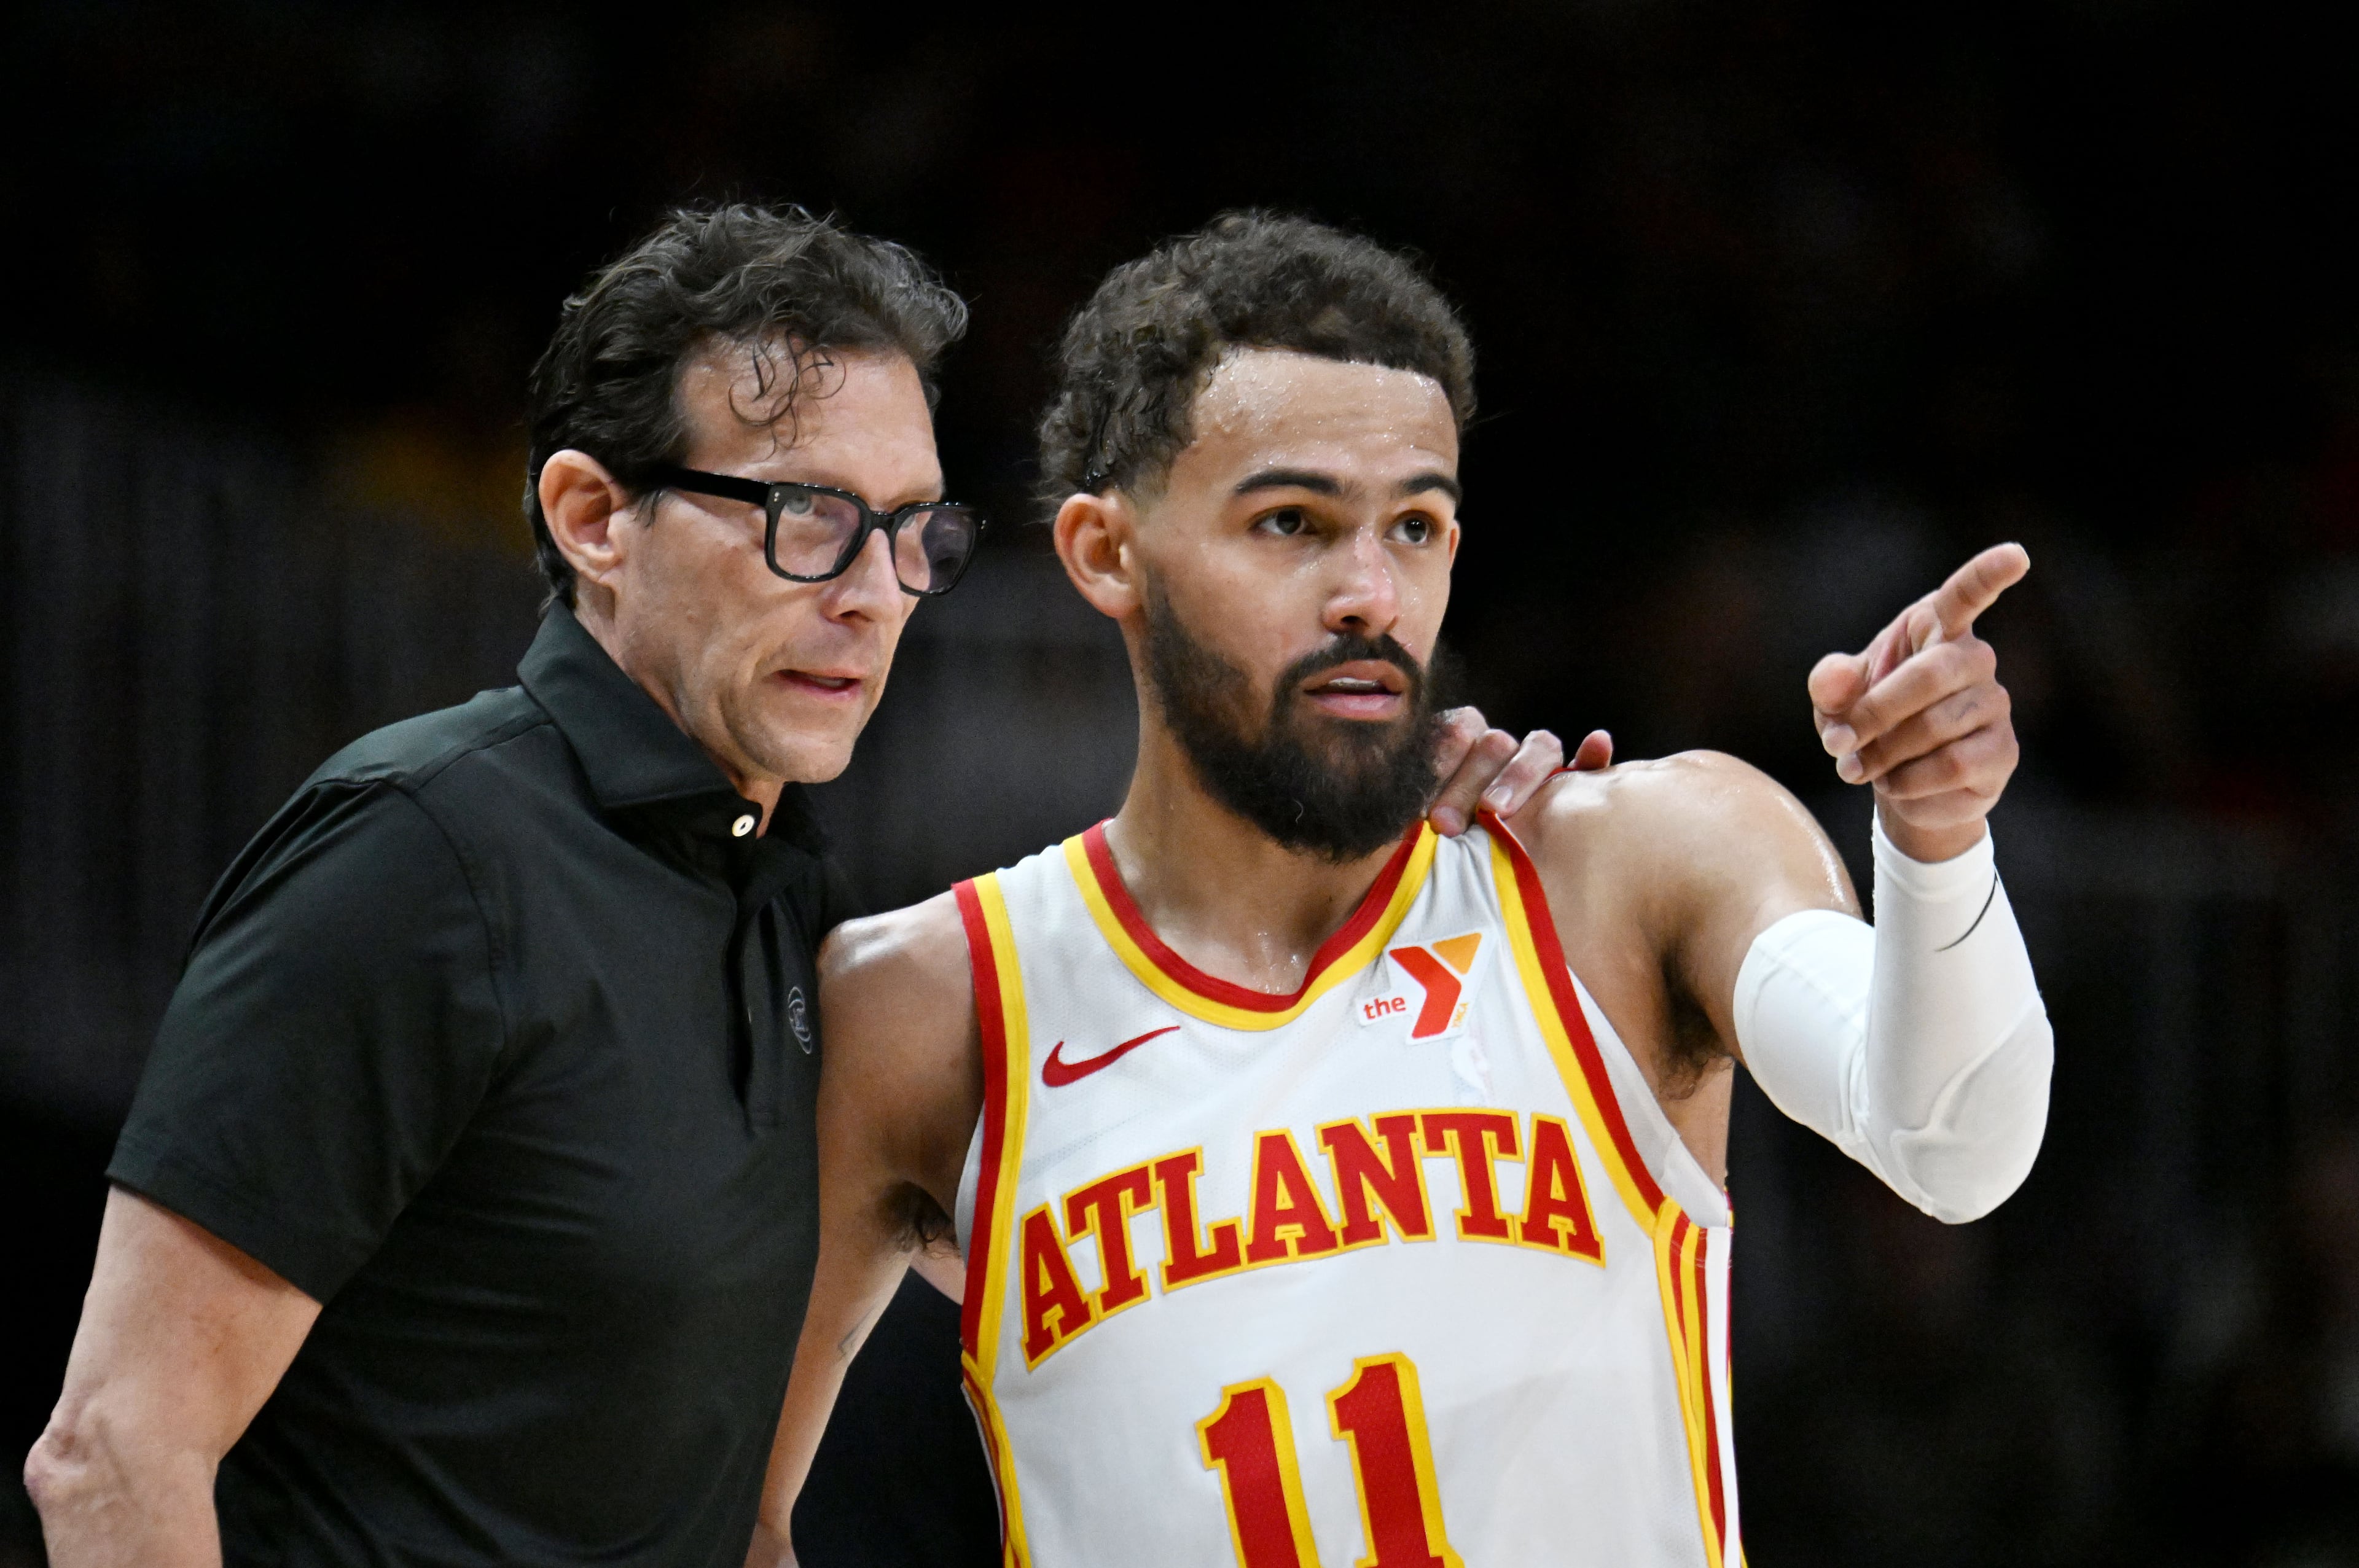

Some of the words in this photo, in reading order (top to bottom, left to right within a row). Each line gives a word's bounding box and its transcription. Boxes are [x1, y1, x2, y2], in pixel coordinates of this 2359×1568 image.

[1363, 997, 1406, 1020] the
[1020, 1109, 1606, 1372] ATLANTA
[1195, 1351, 1466, 1568] 11
